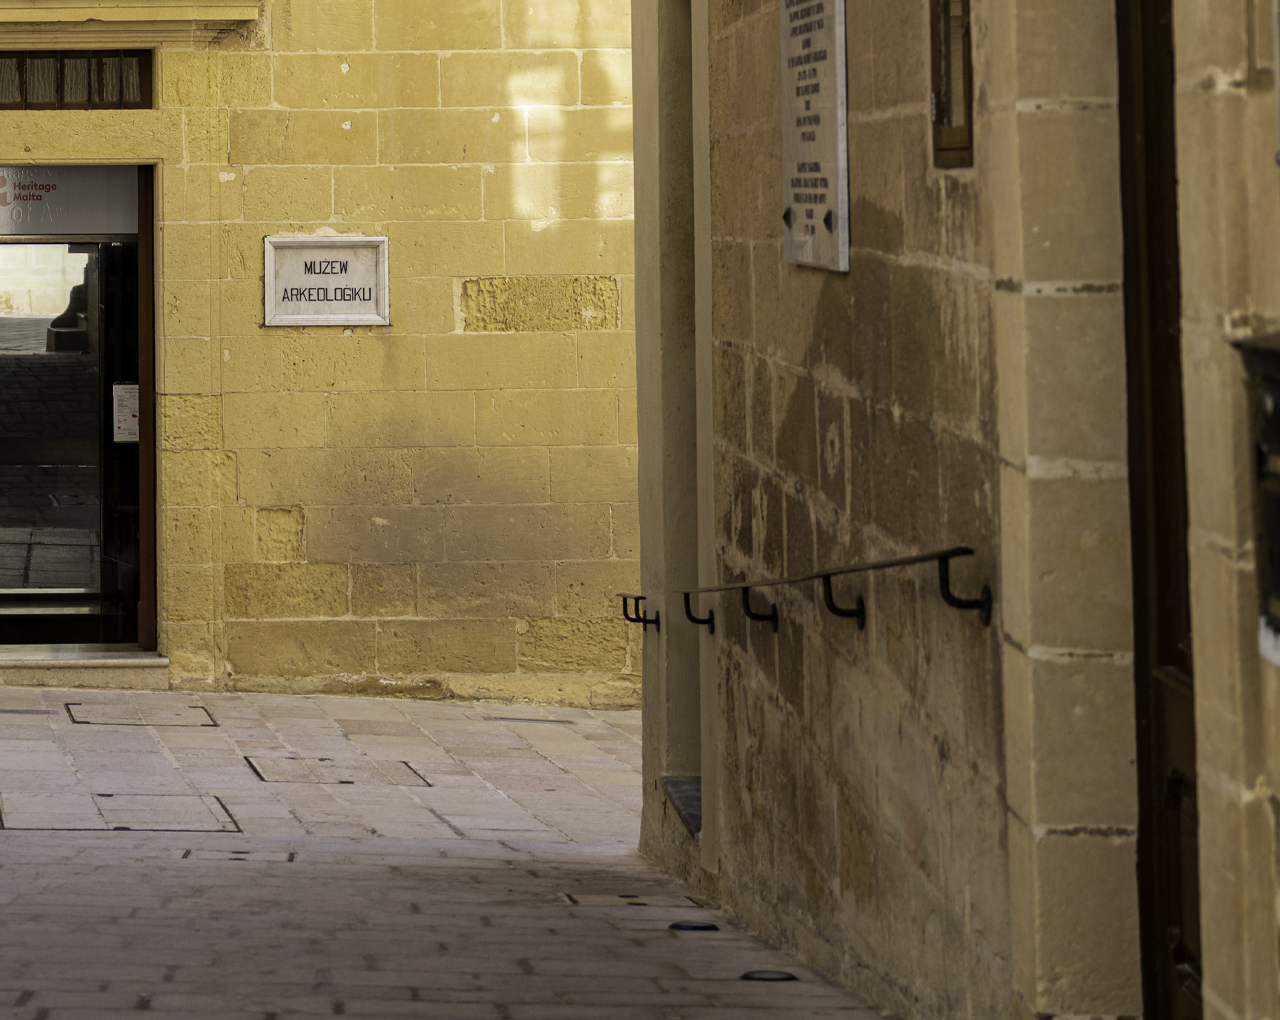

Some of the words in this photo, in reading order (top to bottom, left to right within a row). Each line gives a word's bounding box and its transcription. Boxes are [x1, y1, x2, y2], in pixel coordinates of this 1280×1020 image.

[13, 182, 57, 193] Heritage
[13, 193, 42, 201] Malta
[304, 258, 348, 275] MUŻEW
[282, 284, 372, 302] ARKEOLOĠIKU
